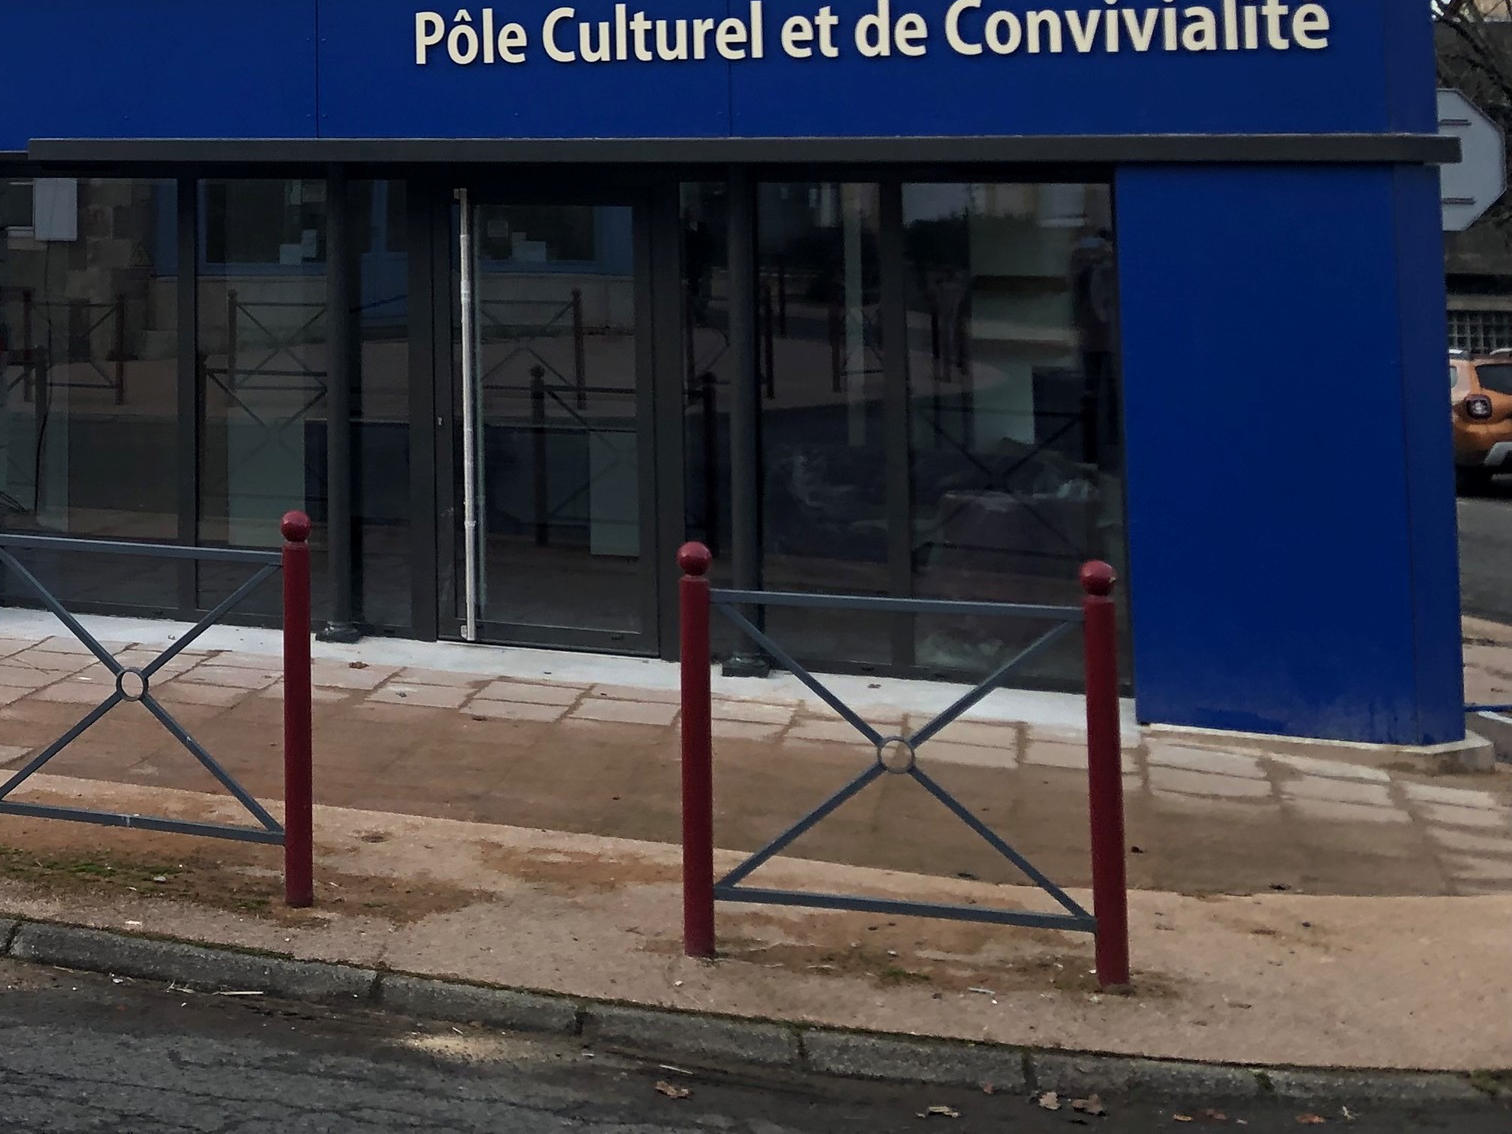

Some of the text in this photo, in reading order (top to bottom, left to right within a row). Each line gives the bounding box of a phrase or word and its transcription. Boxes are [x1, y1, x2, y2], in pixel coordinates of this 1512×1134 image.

[414, 7, 528, 66] Pôle
[541, 0, 764, 64] Culturel
[780, 5, 840, 59] et
